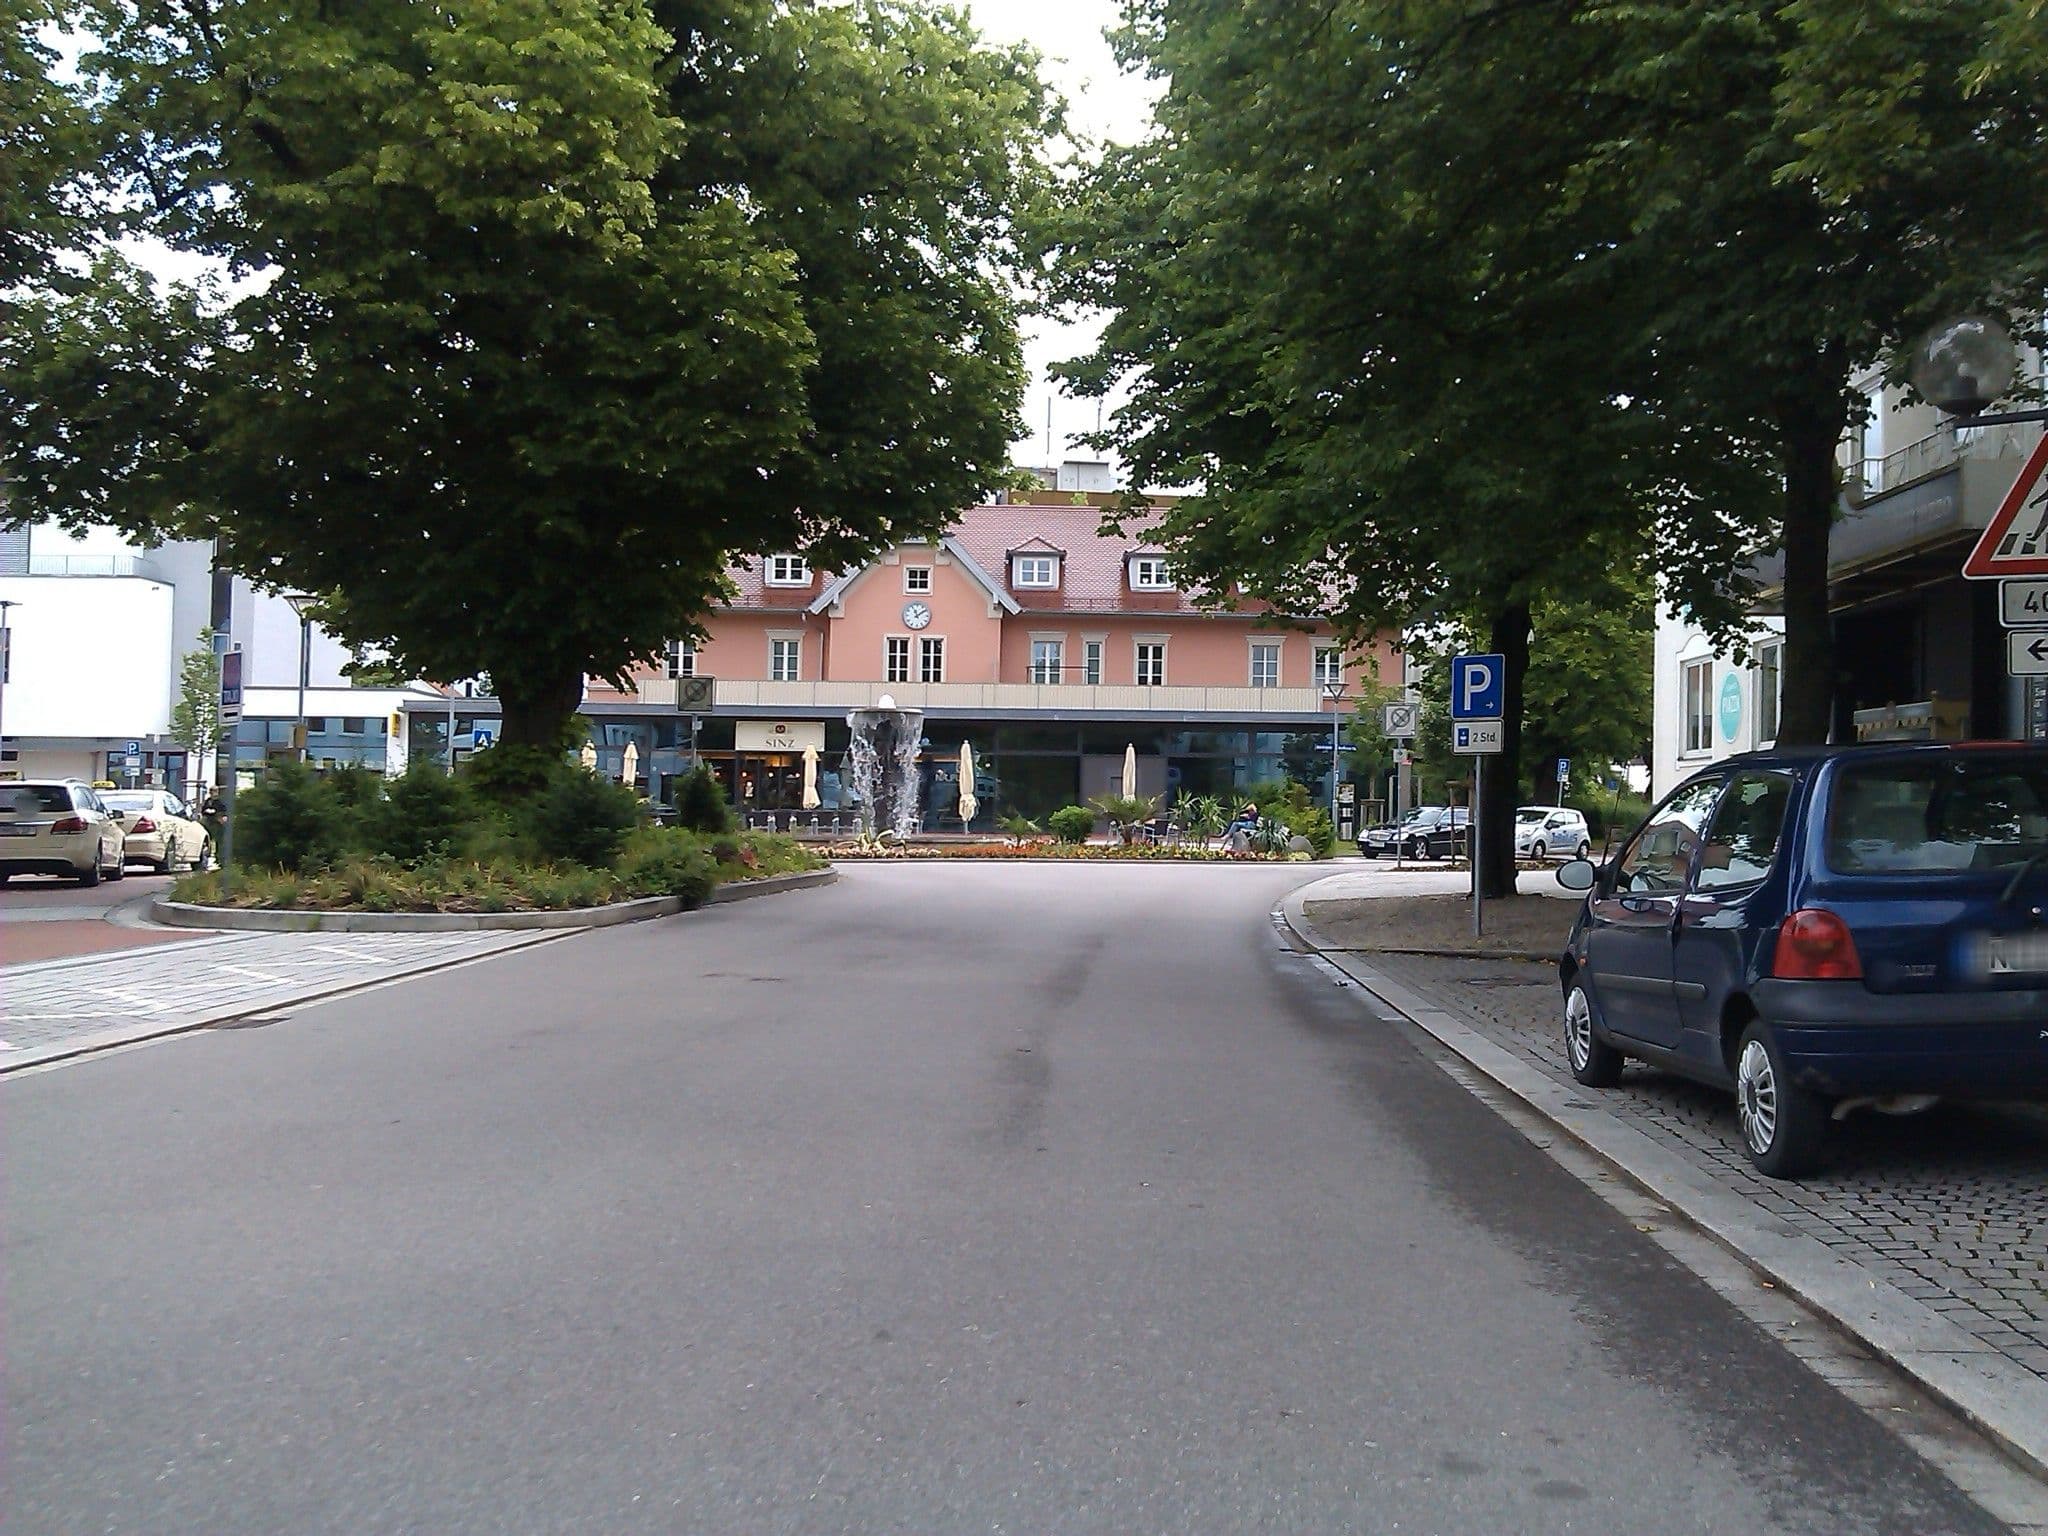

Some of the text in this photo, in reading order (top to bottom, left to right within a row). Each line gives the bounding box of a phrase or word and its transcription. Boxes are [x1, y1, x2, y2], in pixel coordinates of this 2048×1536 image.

[1463, 664, 1492, 711] P
[766, 739, 795, 748] SINZ
[1472, 732, 1479, 743] 2
[128, 742, 137, 755] P
[1560, 761, 1567, 773] P
